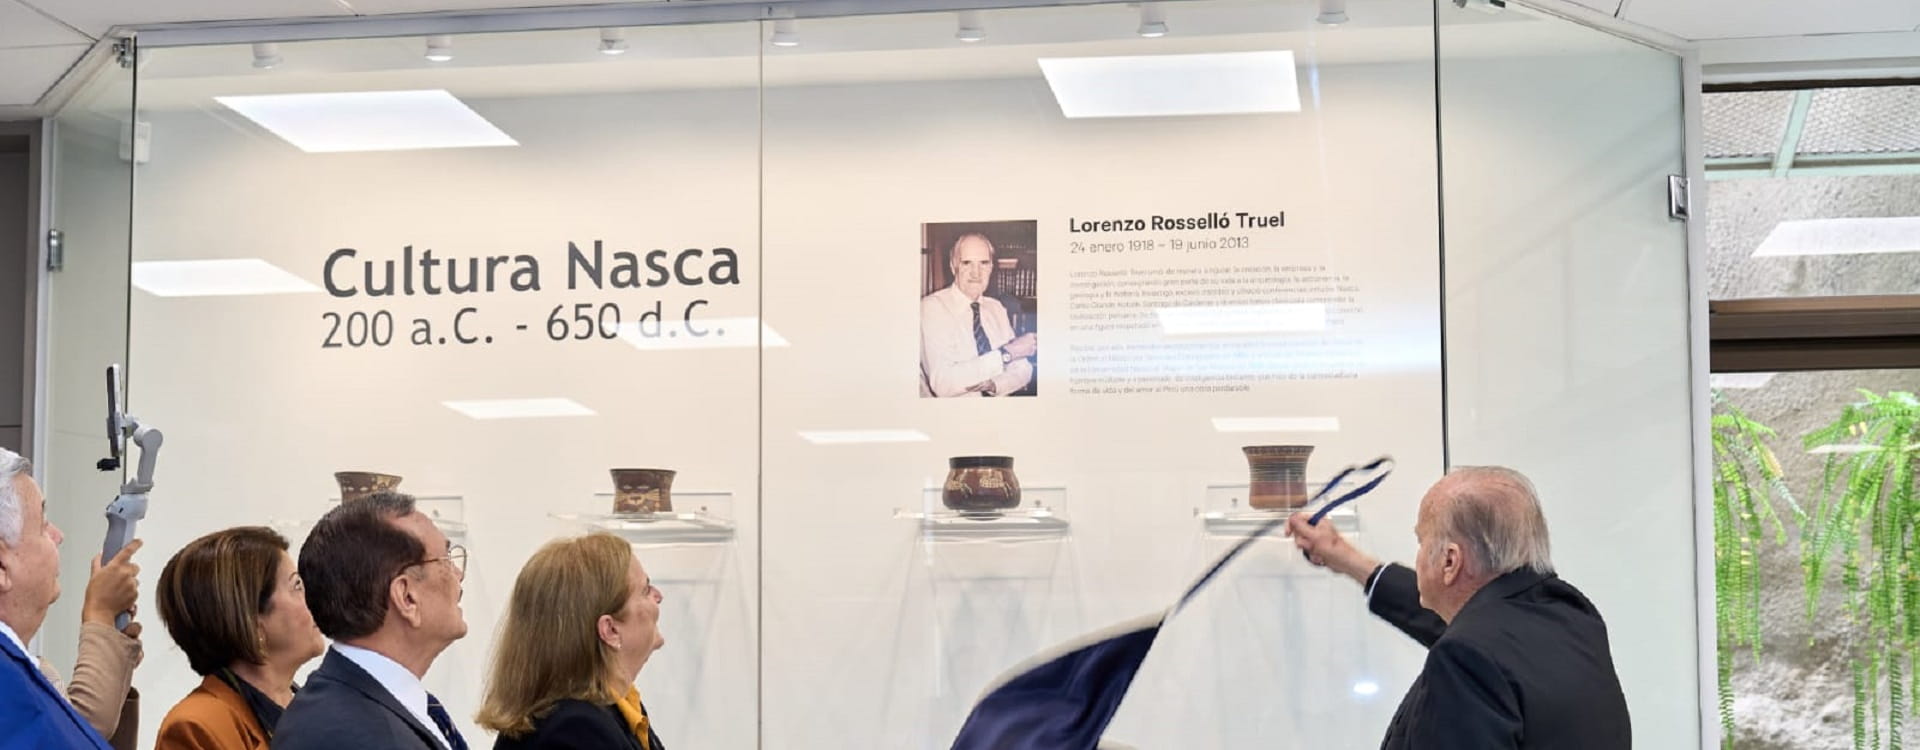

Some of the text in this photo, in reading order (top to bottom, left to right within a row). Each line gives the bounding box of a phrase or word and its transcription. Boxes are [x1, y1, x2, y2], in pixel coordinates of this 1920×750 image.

[1070, 211, 1284, 232] Lorenzo Rosselló Truel
[1070, 242, 1085, 254] 24
[1089, 242, 1125, 253] enero
[1128, 240, 1154, 251] 1918
[1170, 239, 1183, 251] 19
[1186, 238, 1217, 253] junio
[1219, 236, 1249, 249] 2013
[324, 240, 739, 297] Cultura Nasca
[323, 310, 392, 347] 200
[412, 308, 492, 345] a.C.
[546, 302, 620, 341] 650
[639, 300, 725, 338] d.C.
